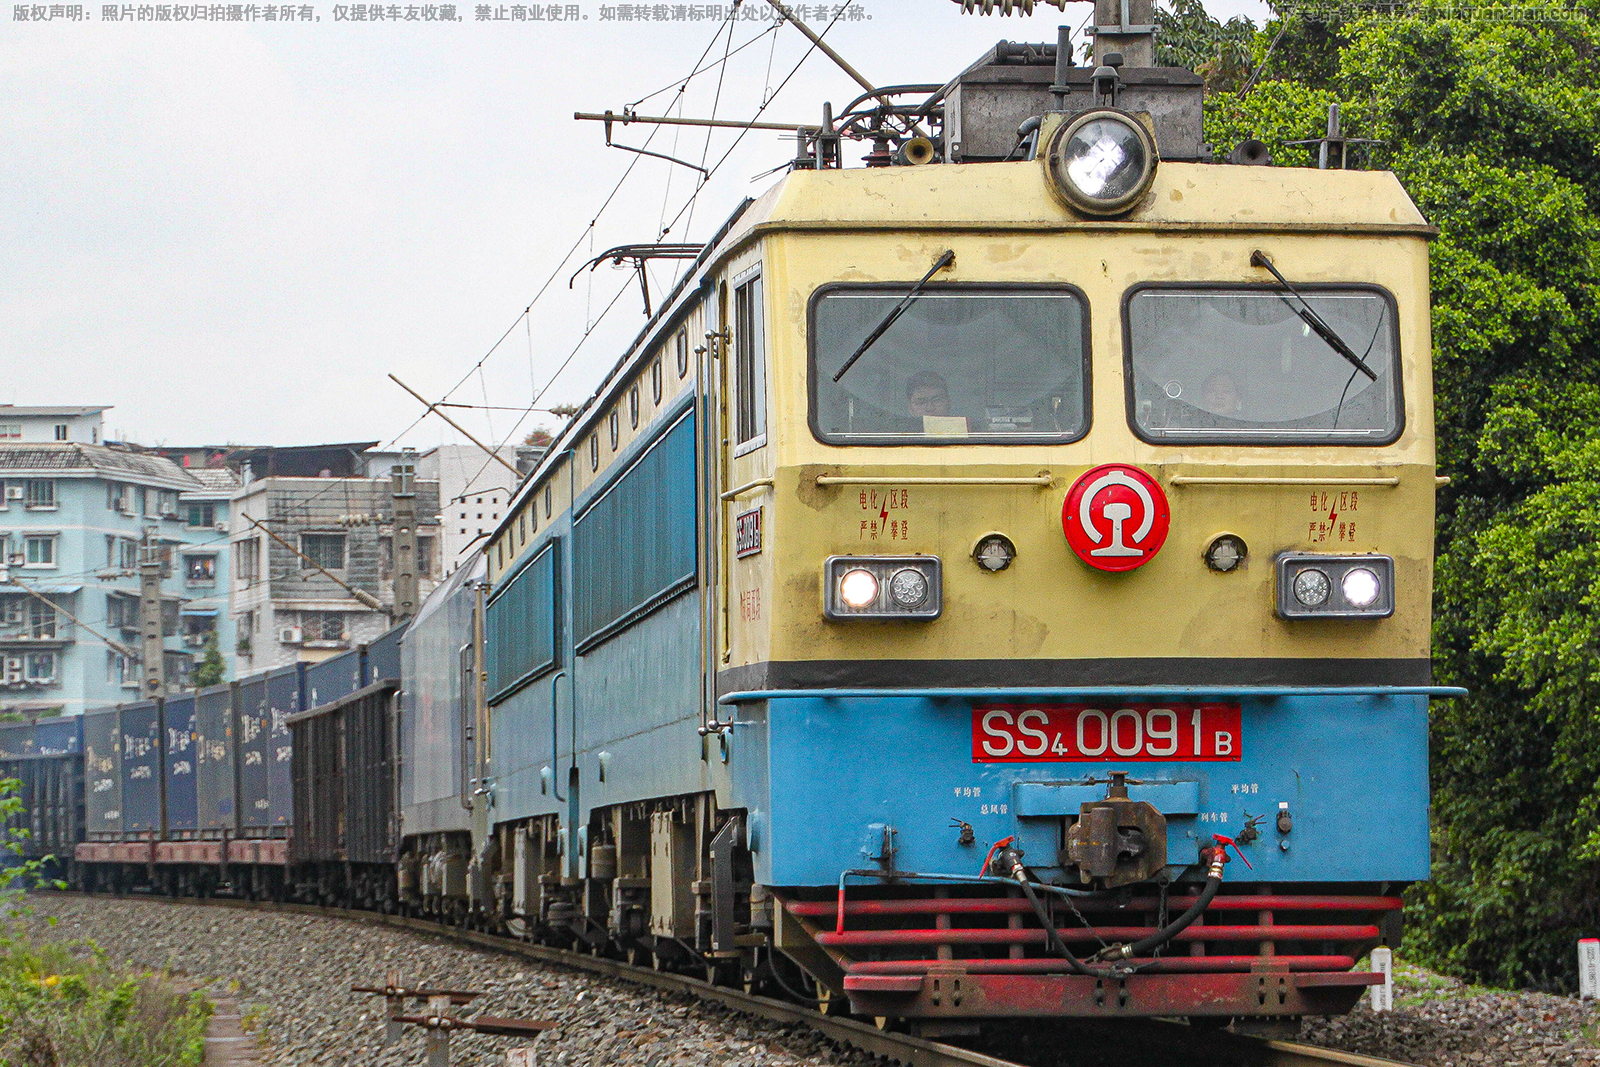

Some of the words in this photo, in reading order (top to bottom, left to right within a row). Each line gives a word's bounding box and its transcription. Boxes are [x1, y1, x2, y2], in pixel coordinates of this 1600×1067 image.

[953, 786, 982, 798] 平均管
[1230, 783, 1260, 795] 平均管
[980, 803, 1009, 815] 总风管
[1200, 811, 1229, 824] 列车管
